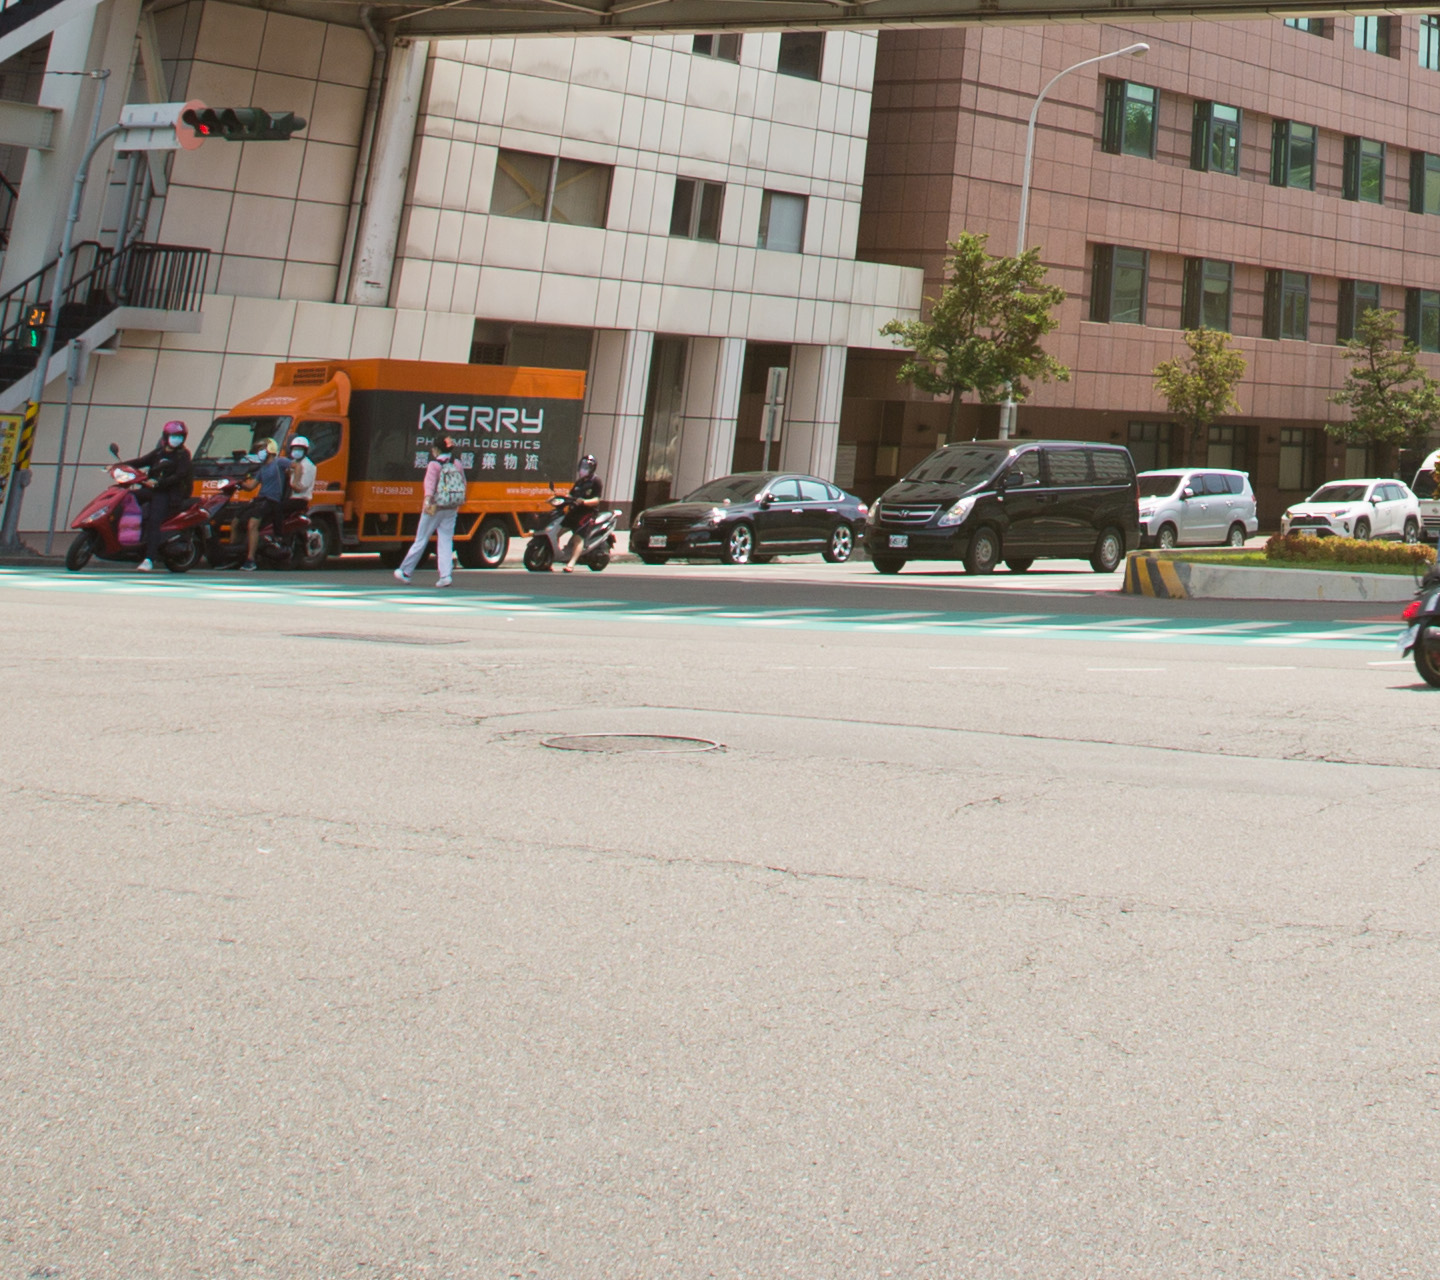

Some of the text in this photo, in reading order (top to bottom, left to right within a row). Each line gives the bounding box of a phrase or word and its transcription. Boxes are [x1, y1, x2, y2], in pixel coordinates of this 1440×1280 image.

[29, 308, 46, 327] 21
[417, 402, 544, 434] KERRY
[416, 436, 542, 450] PHMA LOGISTICS
[414, 451, 540, 471] 嘉醫藥物流
